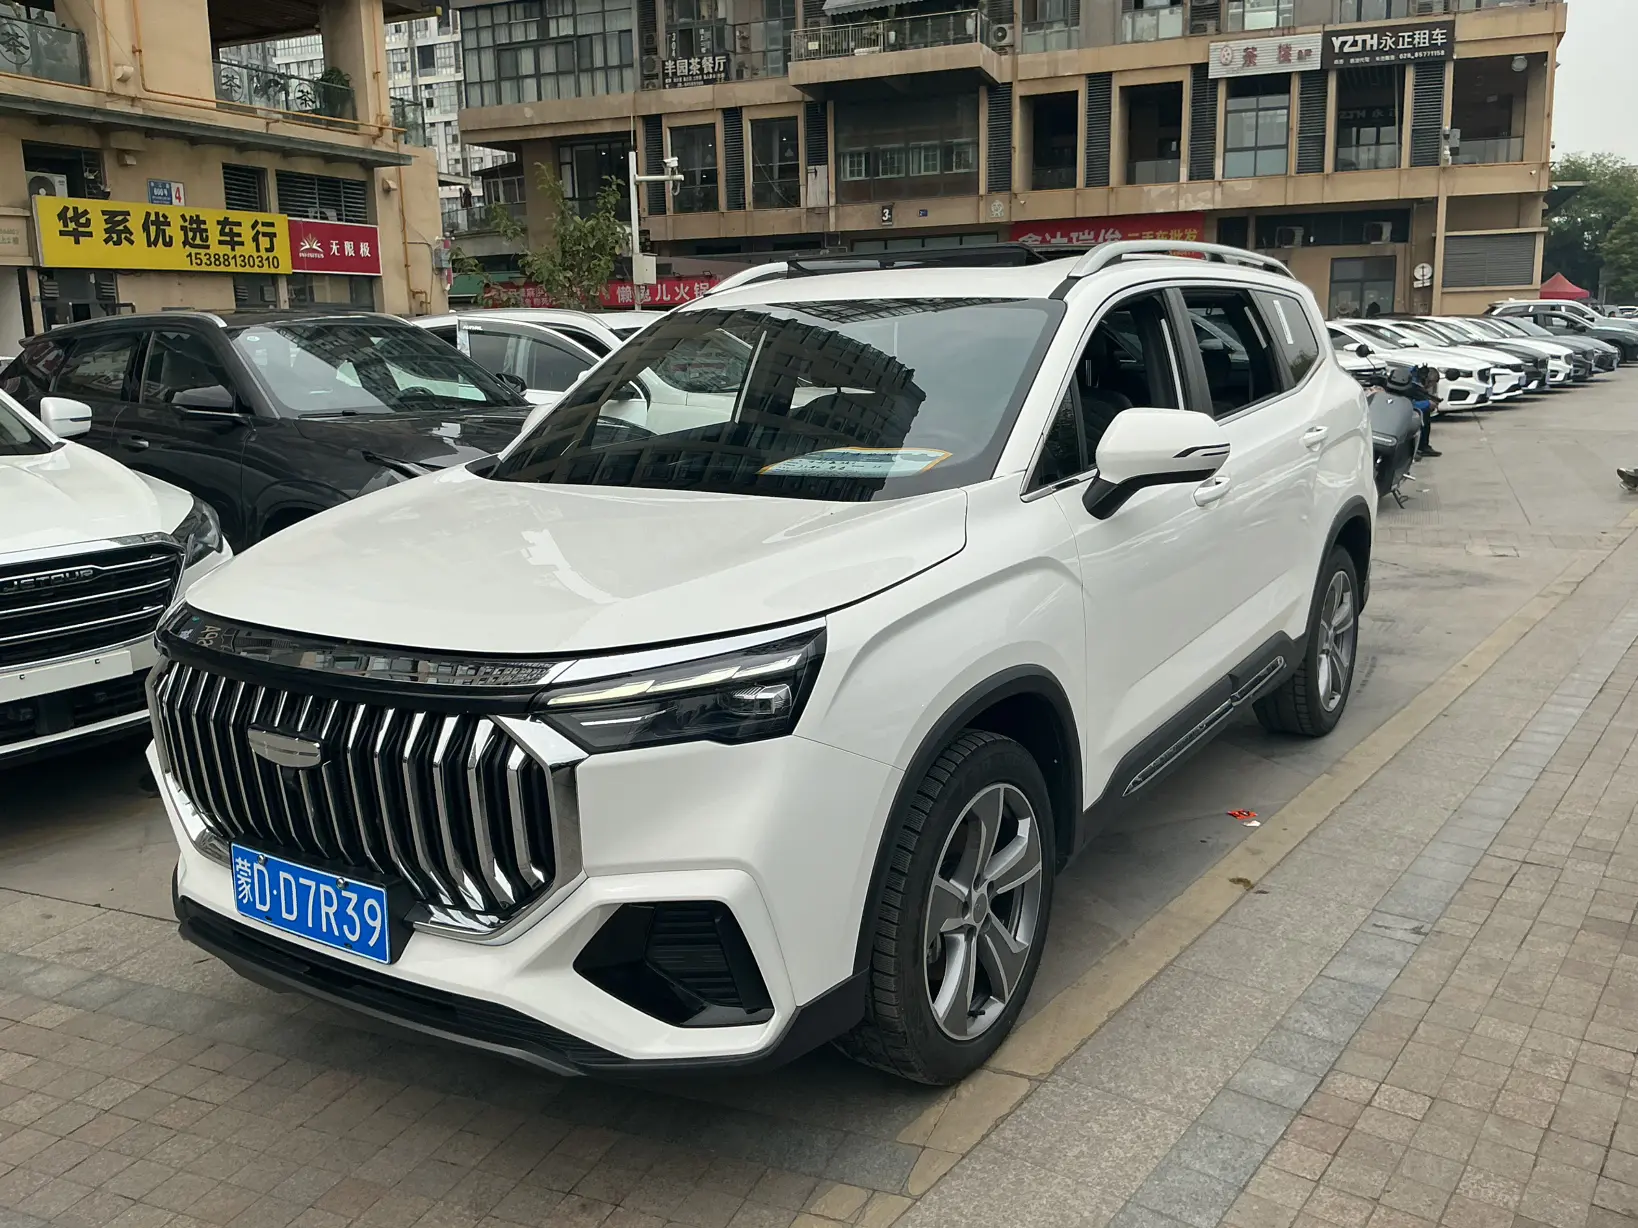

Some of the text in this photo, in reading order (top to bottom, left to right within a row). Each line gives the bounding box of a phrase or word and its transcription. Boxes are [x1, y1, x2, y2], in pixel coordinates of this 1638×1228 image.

[1379, 28, 1447, 51] 永正租车
[175, 186, 182, 203] 4
[882, 208, 889, 221] 3
[57, 205, 277, 253] 华系优选车行
[330, 240, 371, 258] 无限极
[186, 251, 280, 269] 15388130310
[3, 569, 93, 592] JETOUR
